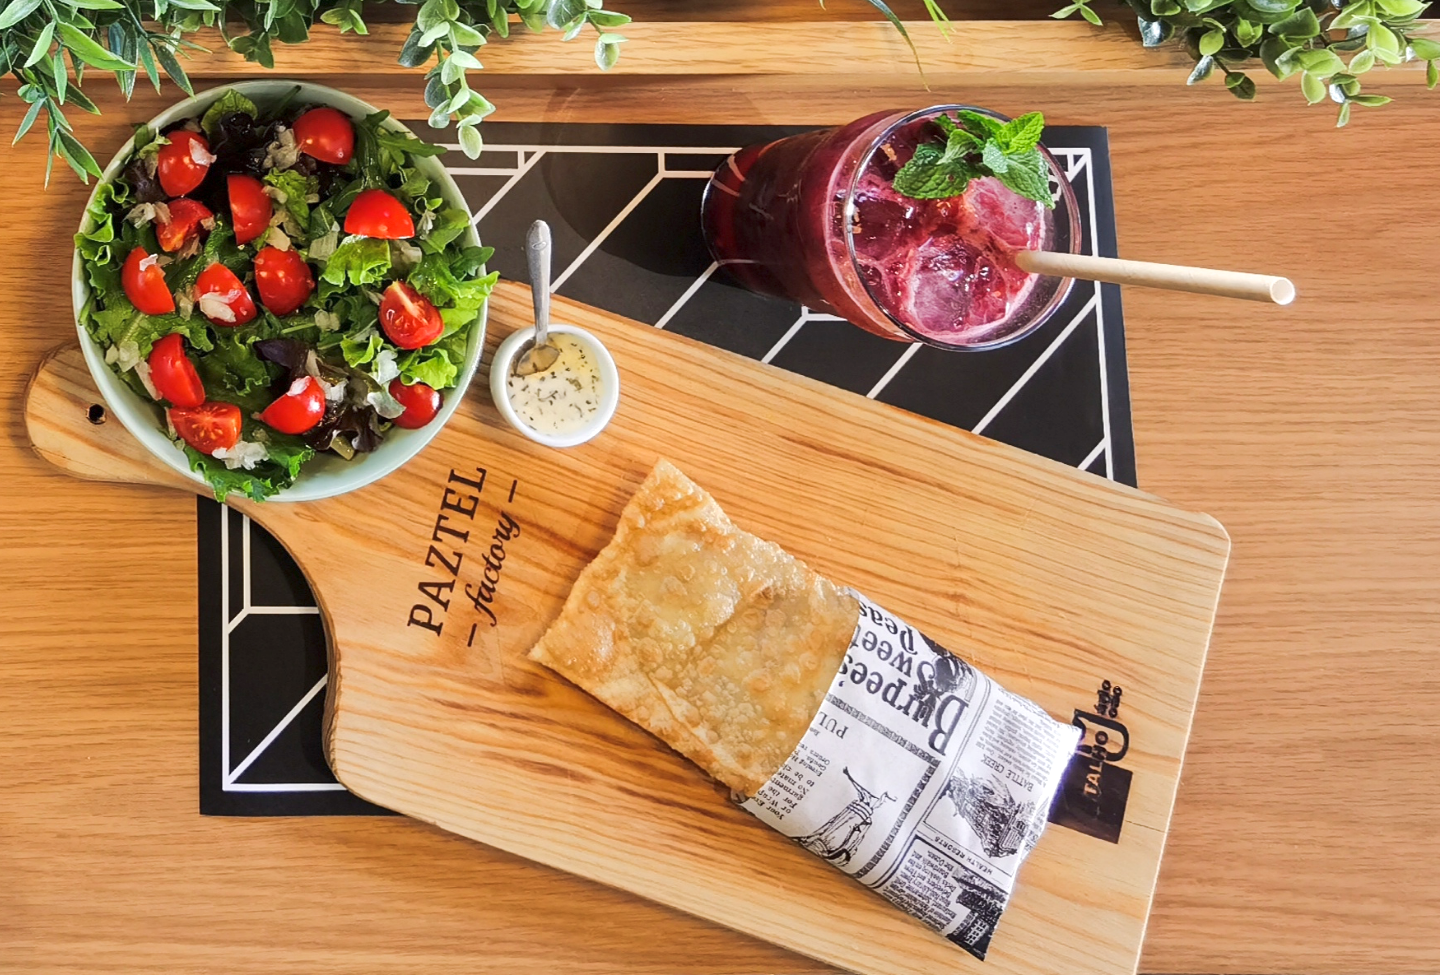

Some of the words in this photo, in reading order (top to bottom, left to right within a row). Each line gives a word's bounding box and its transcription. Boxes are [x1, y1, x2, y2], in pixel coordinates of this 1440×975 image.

[407, 467, 487, 637] PAZTEL
[465, 510, 521, 627] factory
[844, 622, 940, 691] Sweet
[979, 753, 1005, 774] CREEK
[796, 783, 809, 795] No
[1004, 768, 1034, 791] BATTLE
[767, 785, 780, 797] the
[781, 795, 797, 808] For
[765, 804, 784, 820] Your
[933, 835, 965, 858] RESORTS
[920, 857, 949, 878] Boardwalk
[921, 865, 941, 883] looking
[965, 856, 992, 875] HEALTH
